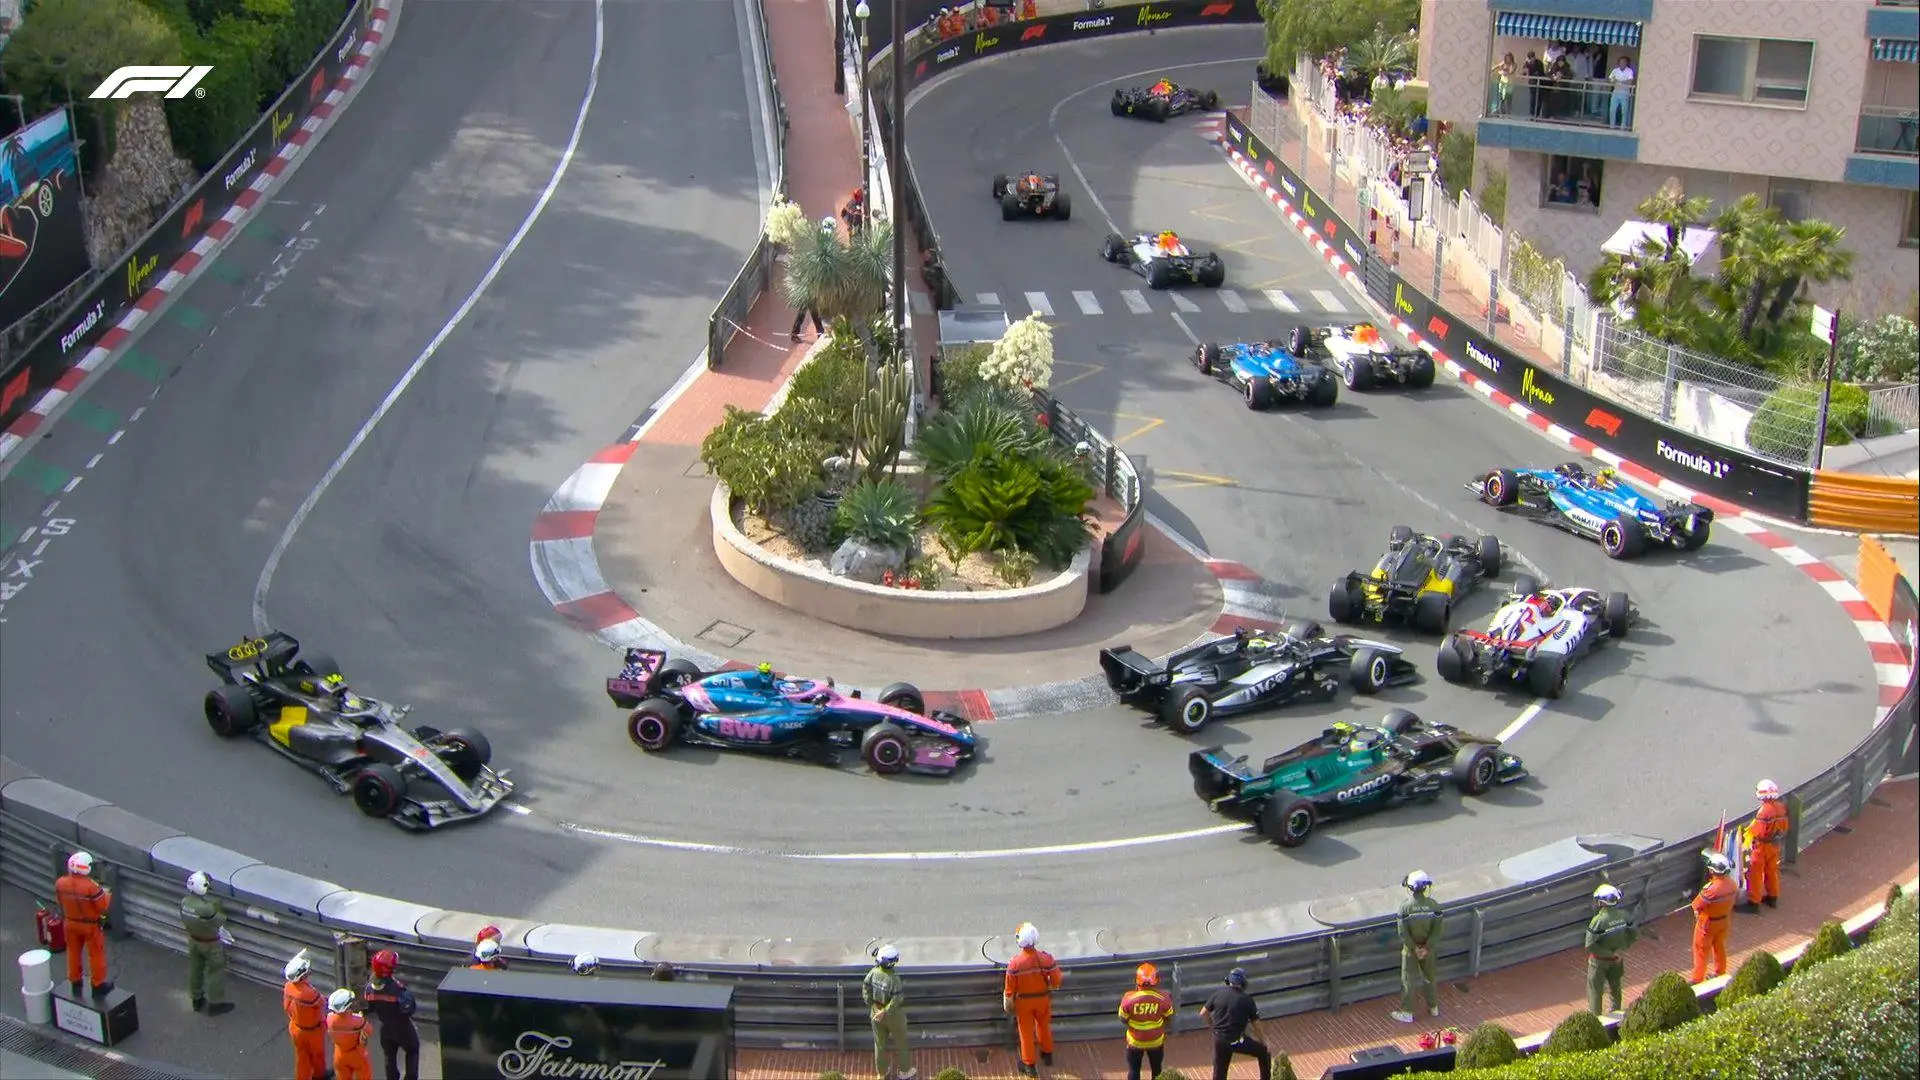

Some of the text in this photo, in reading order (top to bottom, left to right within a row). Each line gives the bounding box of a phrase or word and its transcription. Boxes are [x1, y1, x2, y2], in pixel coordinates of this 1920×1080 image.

[1073, 18, 1105, 30] Formula
[1137, 3, 1172, 26] Monaco
[225, 157, 251, 190] Formula
[128, 255, 159, 298] Monaco
[61, 310, 97, 353] Formula
[1465, 341, 1491, 368] Formula
[1522, 367, 1554, 404] Monaco
[1657, 440, 1711, 474] Formula
[676, 673, 691, 685] 43
[720, 718, 772, 741] BWT
[1337, 774, 1391, 801] aramco
[1133, 1002, 1159, 1015] CSPM
[497, 1030, 667, 1080] Fairmont
